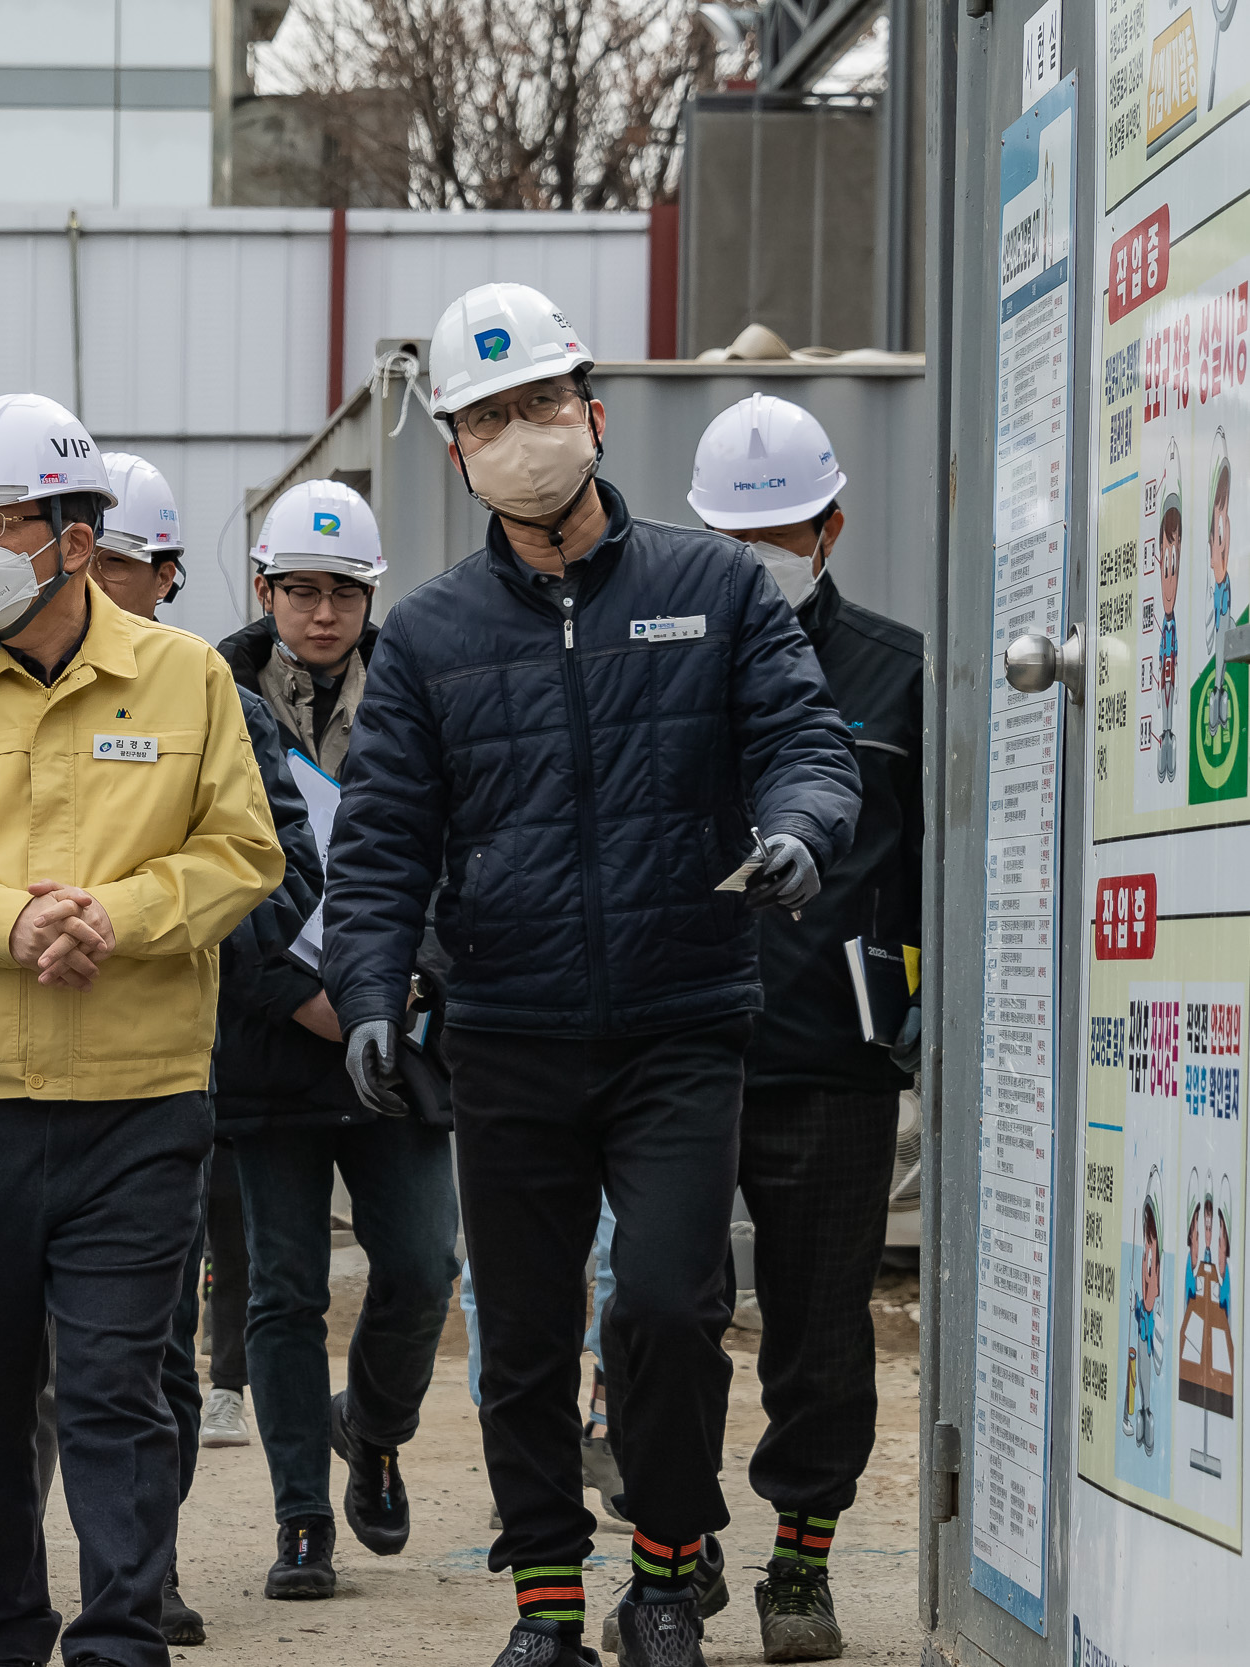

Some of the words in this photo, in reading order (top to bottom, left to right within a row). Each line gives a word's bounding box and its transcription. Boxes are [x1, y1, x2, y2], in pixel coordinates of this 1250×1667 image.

[1025, 9, 1057, 91] 시험실
[1115, 222, 1159, 306] 작업중
[1199, 280, 1249, 405] 성실시공
[50, 438, 91, 459] VIP
[1102, 886, 1146, 949] 작업후
[867, 946, 888, 959] 2023
[1091, 1016, 1112, 1068] 정리정돈
[1113, 1016, 1126, 1068] 철저
[1129, 999, 1149, 1094] 작업후
[1151, 1000, 1180, 1099] 정리정돈
[1186, 1003, 1209, 1055] 작업전
[1210, 1003, 1241, 1057] 안전회의
[1185, 1064, 1207, 1117] 작업후
[1209, 1065, 1240, 1120] 확인철저
